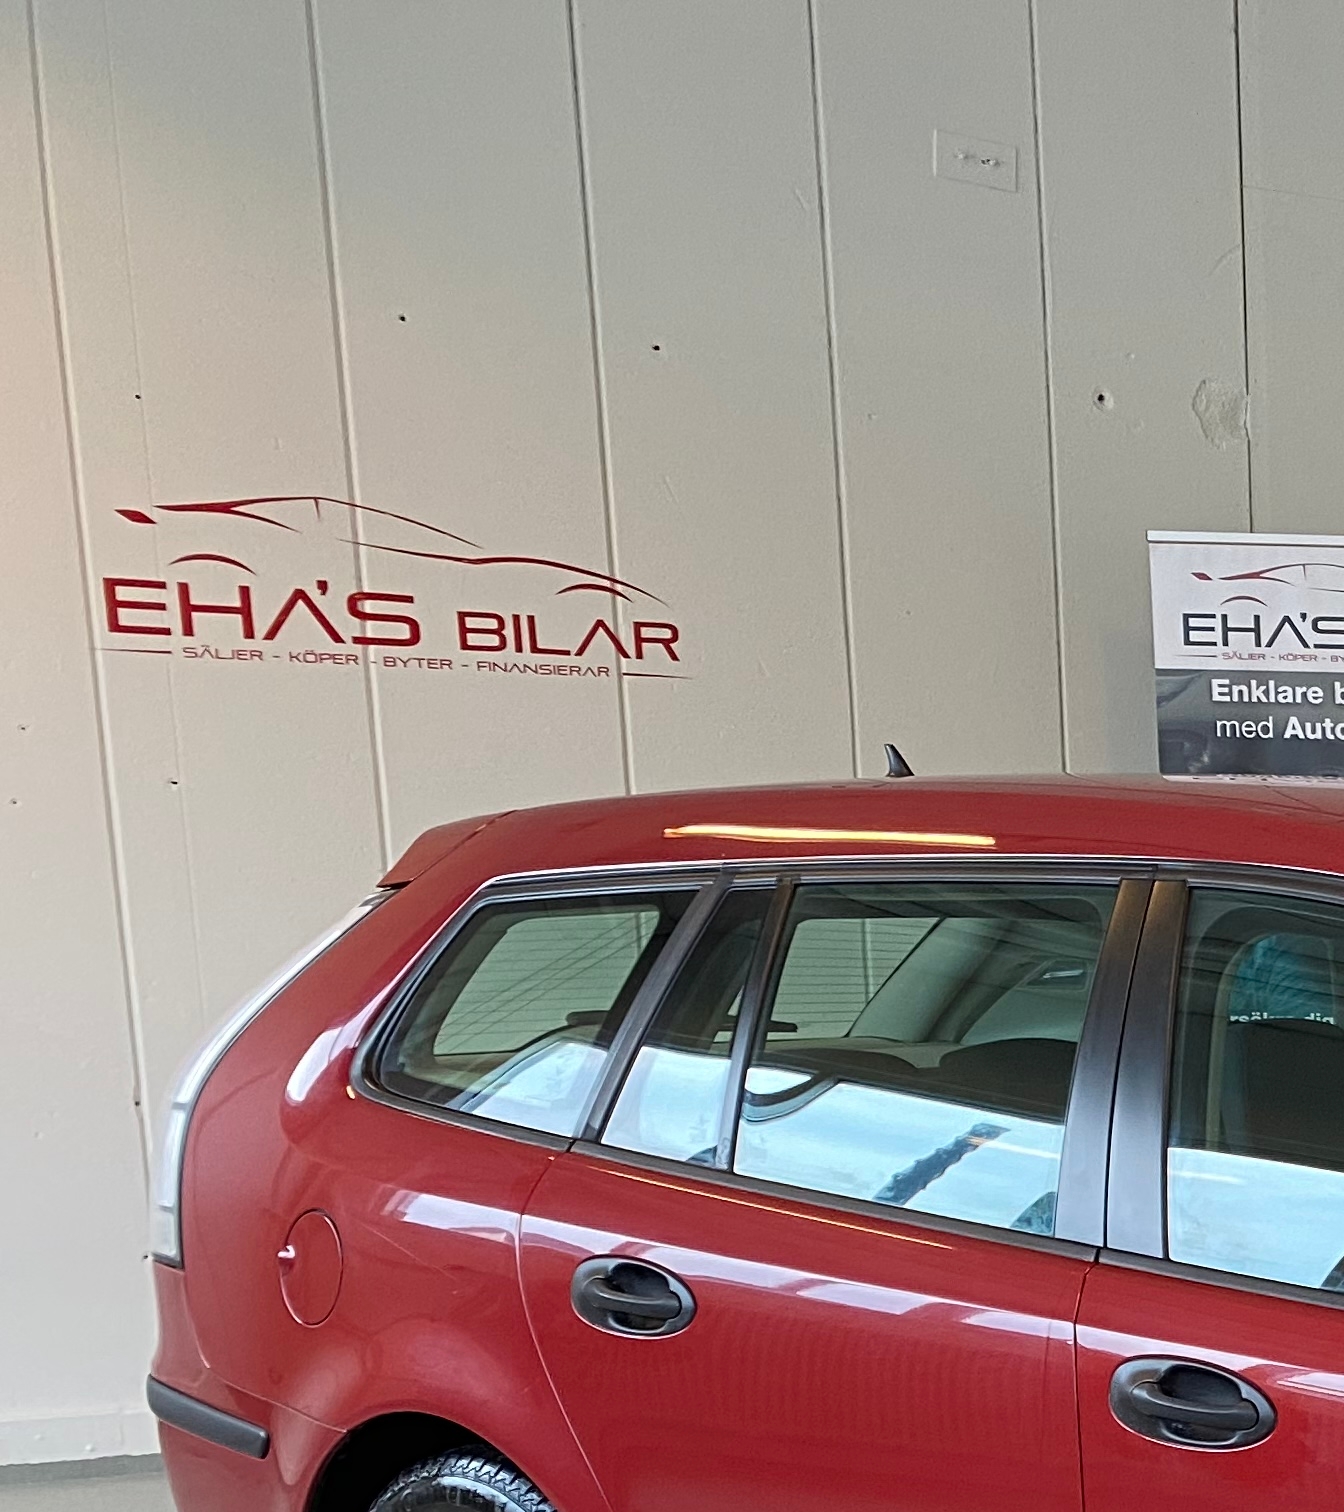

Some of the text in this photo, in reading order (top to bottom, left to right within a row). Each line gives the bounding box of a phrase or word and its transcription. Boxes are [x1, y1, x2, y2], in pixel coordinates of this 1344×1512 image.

[102, 577, 681, 662] EHA'S BILAR
[288, 649, 359, 666] KÖPER
[383, 656, 453, 670] BYTER
[476, 660, 610, 677] FINANSIERAR
[1278, 652, 1318, 662] KÖPER
[1211, 678, 1324, 705] Enklare
[1216, 716, 1274, 738] med
